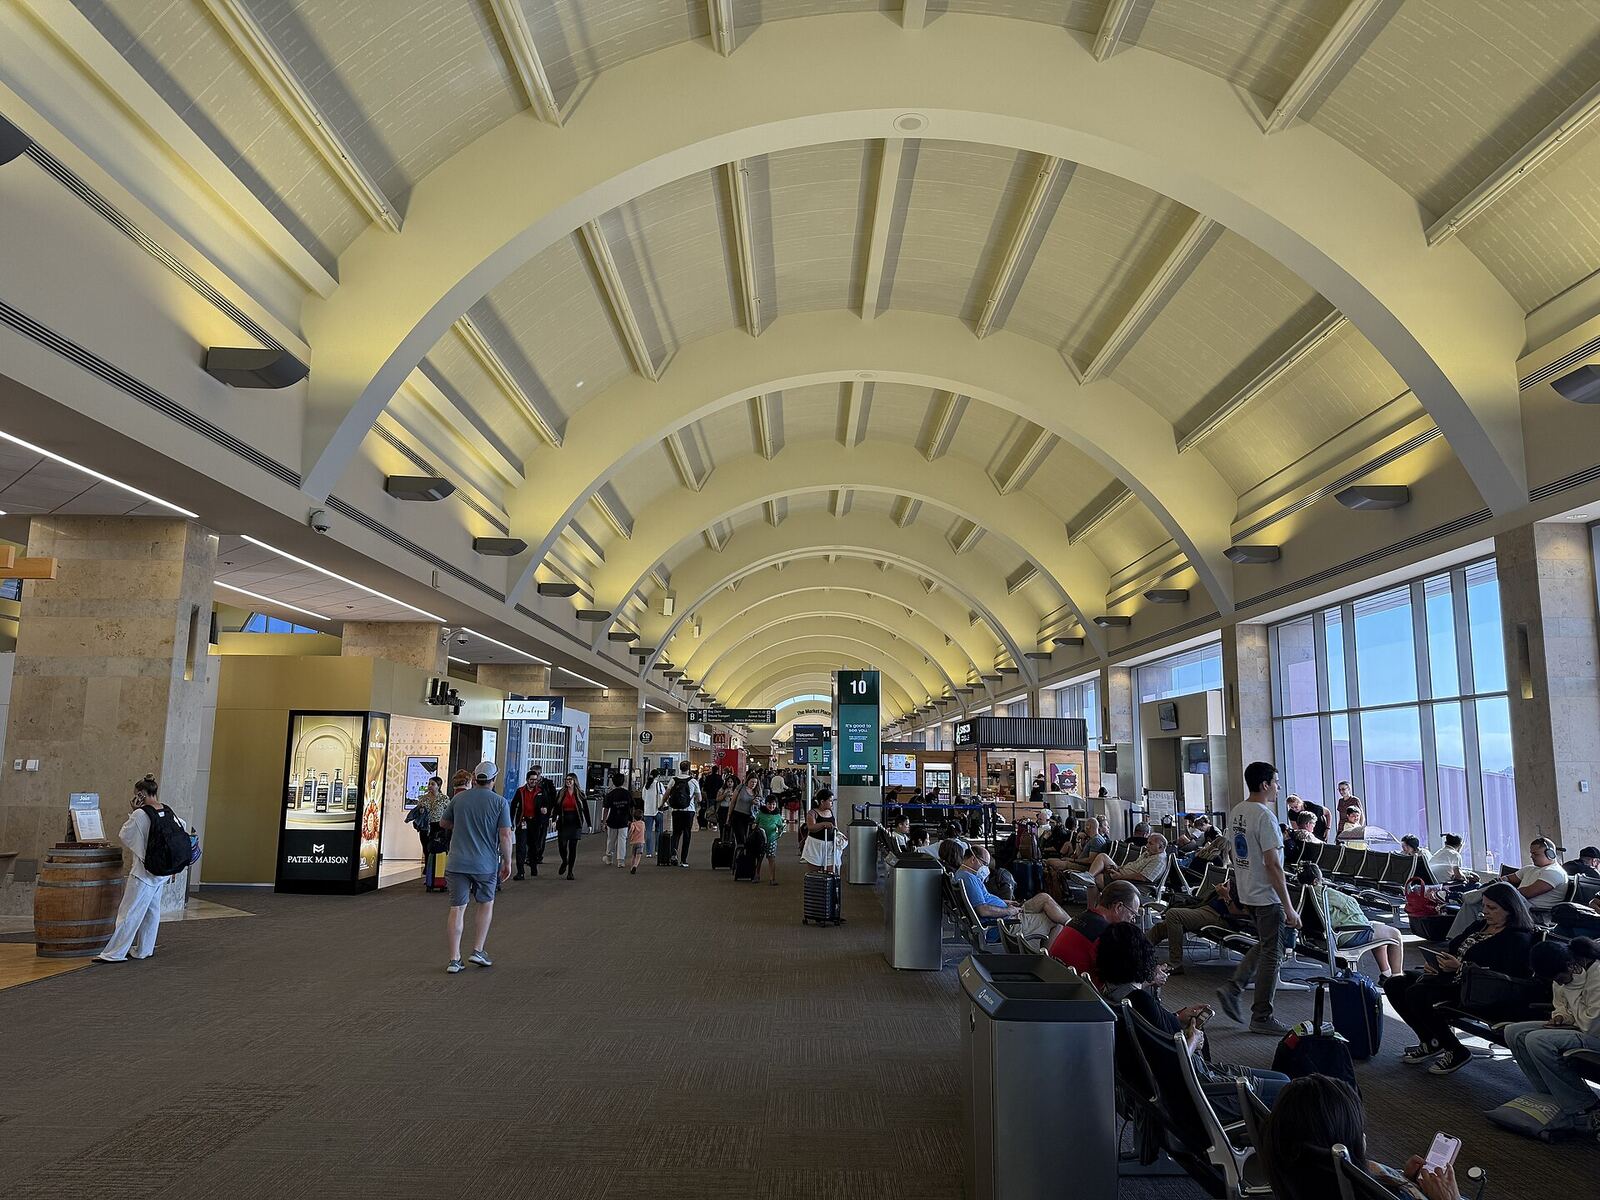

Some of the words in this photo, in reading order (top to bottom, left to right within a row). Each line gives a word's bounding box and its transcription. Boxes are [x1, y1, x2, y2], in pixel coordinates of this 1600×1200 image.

[850, 680, 867, 694] 10
[799, 748, 804, 756] 1
[287, 855, 313, 864] PATEK
[315, 856, 349, 864] MAISON
